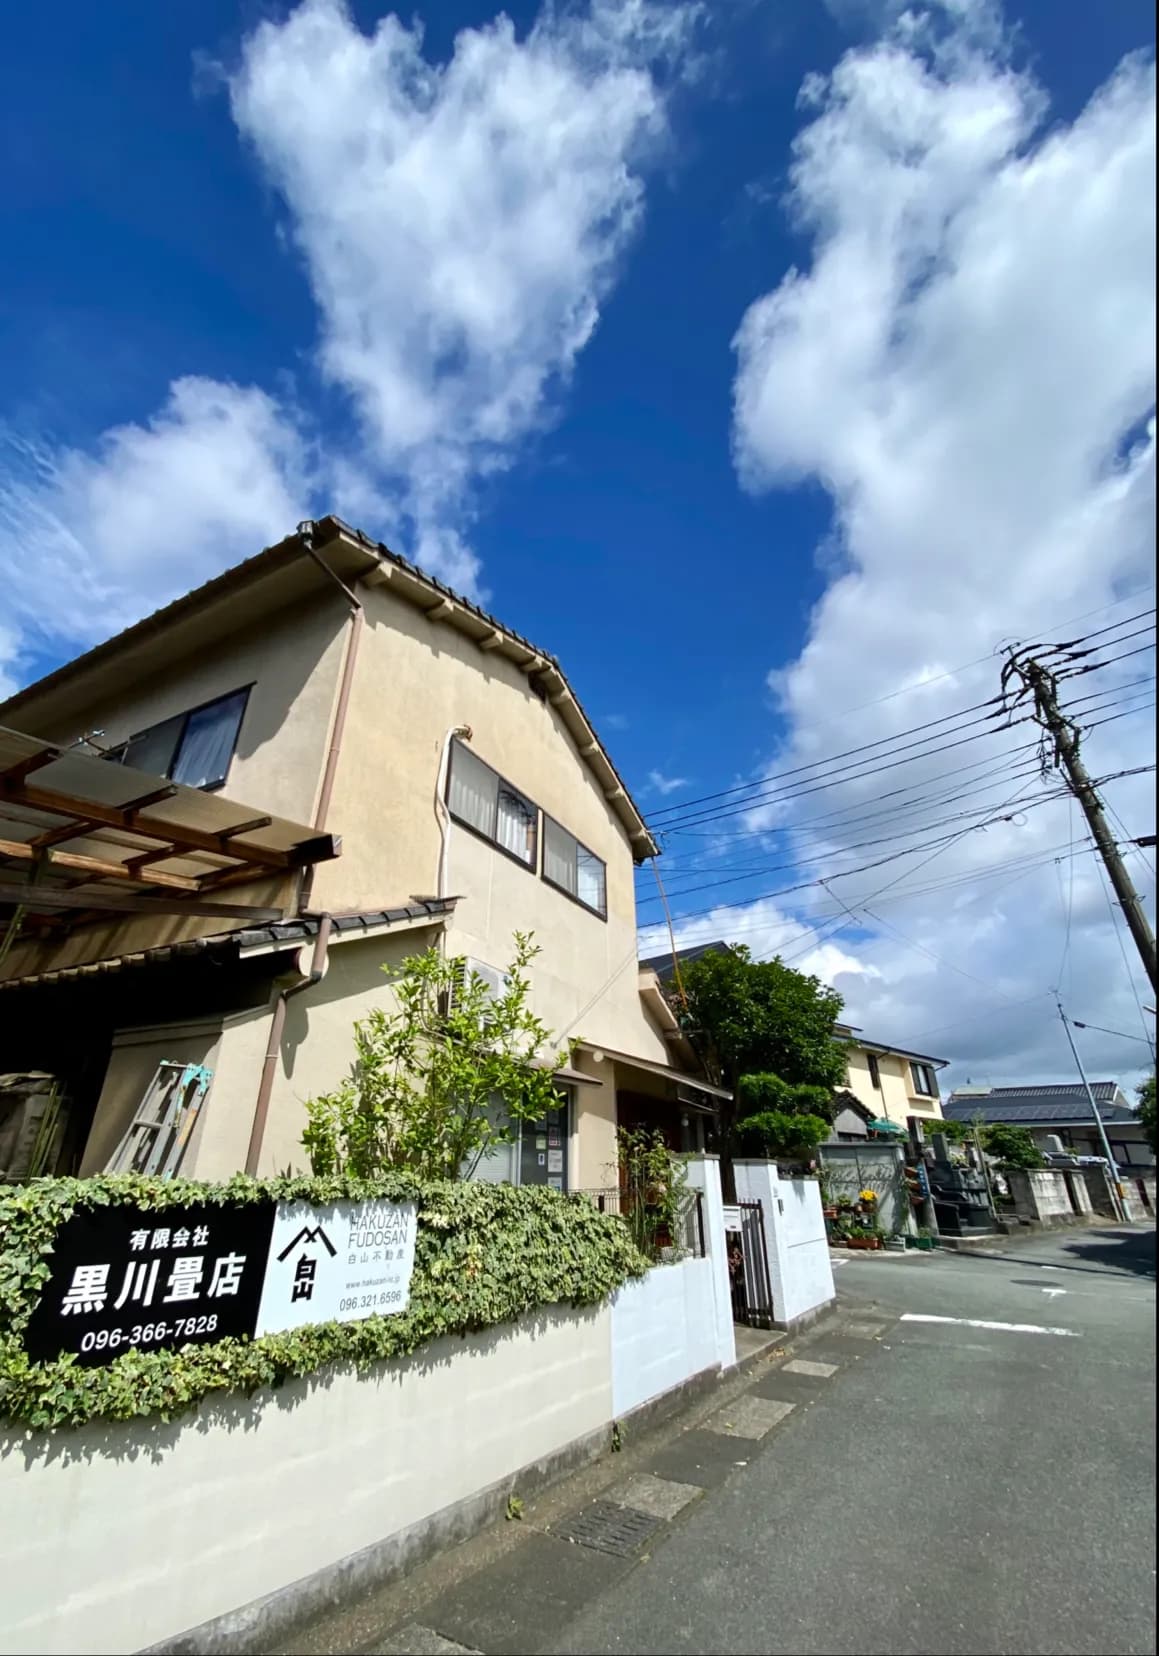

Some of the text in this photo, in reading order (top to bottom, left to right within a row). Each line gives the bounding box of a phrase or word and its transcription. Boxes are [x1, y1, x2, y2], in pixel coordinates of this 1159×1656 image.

[350, 1211, 408, 1231] HAKUZAN
[130, 1225, 210, 1251] 有限会社
[348, 1229, 408, 1249] FUDOSAN
[60, 1252, 247, 1316] 黒川畳店
[339, 1290, 402, 1311] 096.321.6596
[80, 1315, 218, 1352] 096-366-7828
